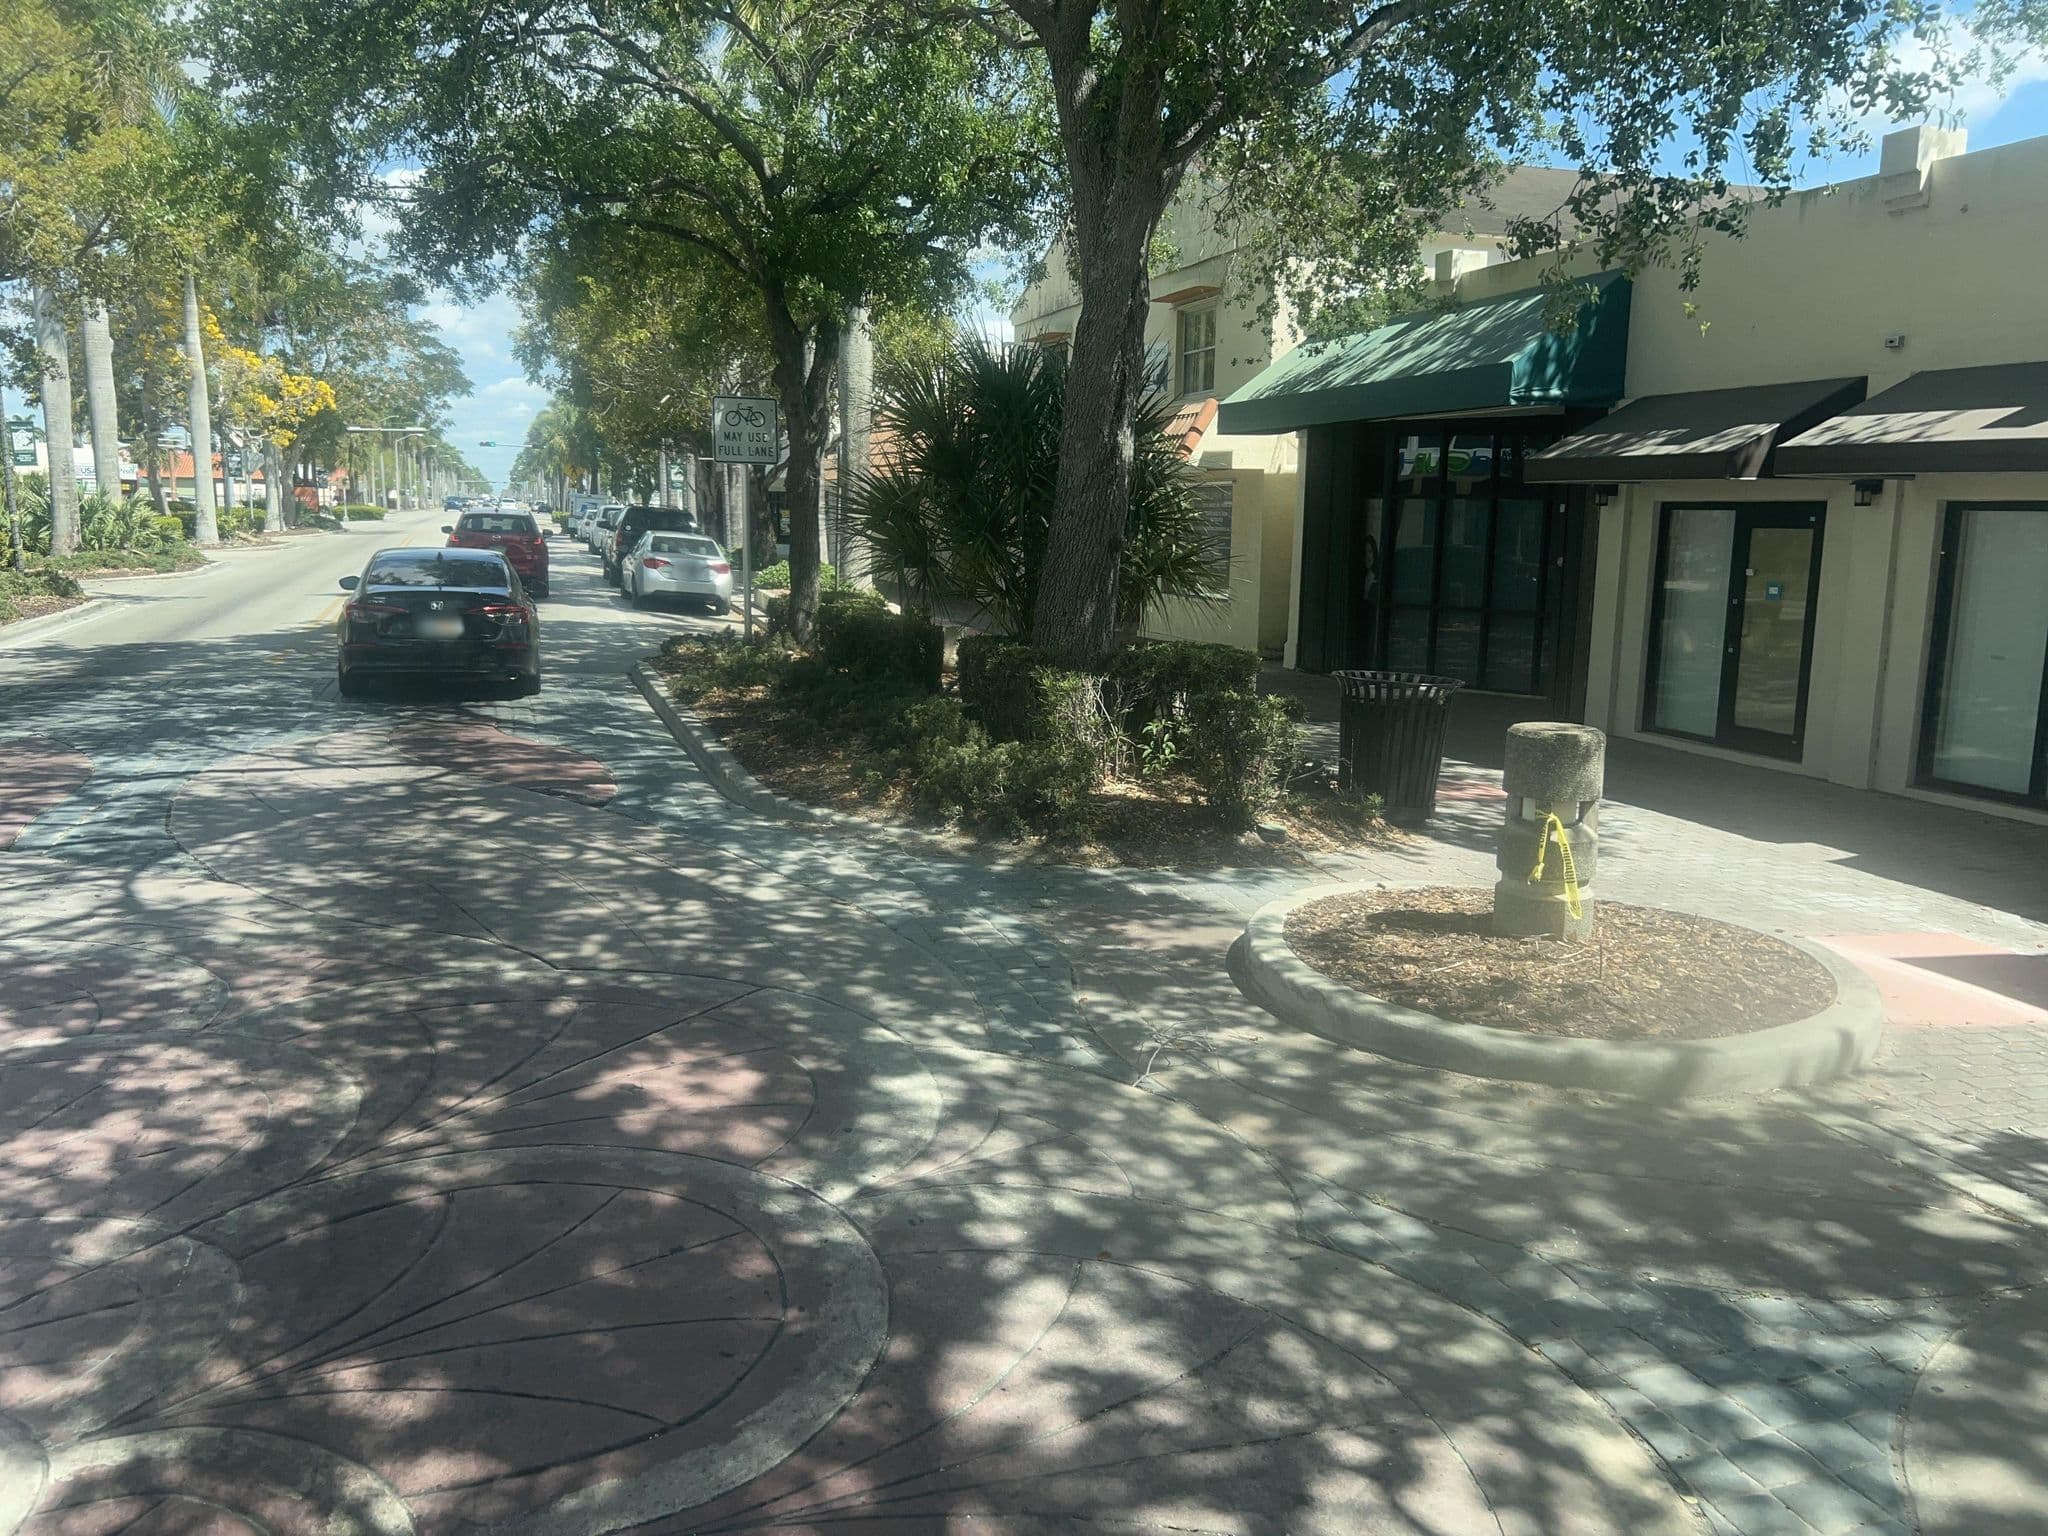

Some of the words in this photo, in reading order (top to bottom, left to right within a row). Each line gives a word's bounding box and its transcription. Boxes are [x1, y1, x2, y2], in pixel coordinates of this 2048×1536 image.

[723, 431, 743, 442] MAY
[748, 432, 769, 443] USE
[718, 445, 743, 456] FULL
[748, 446, 774, 457] LANE
